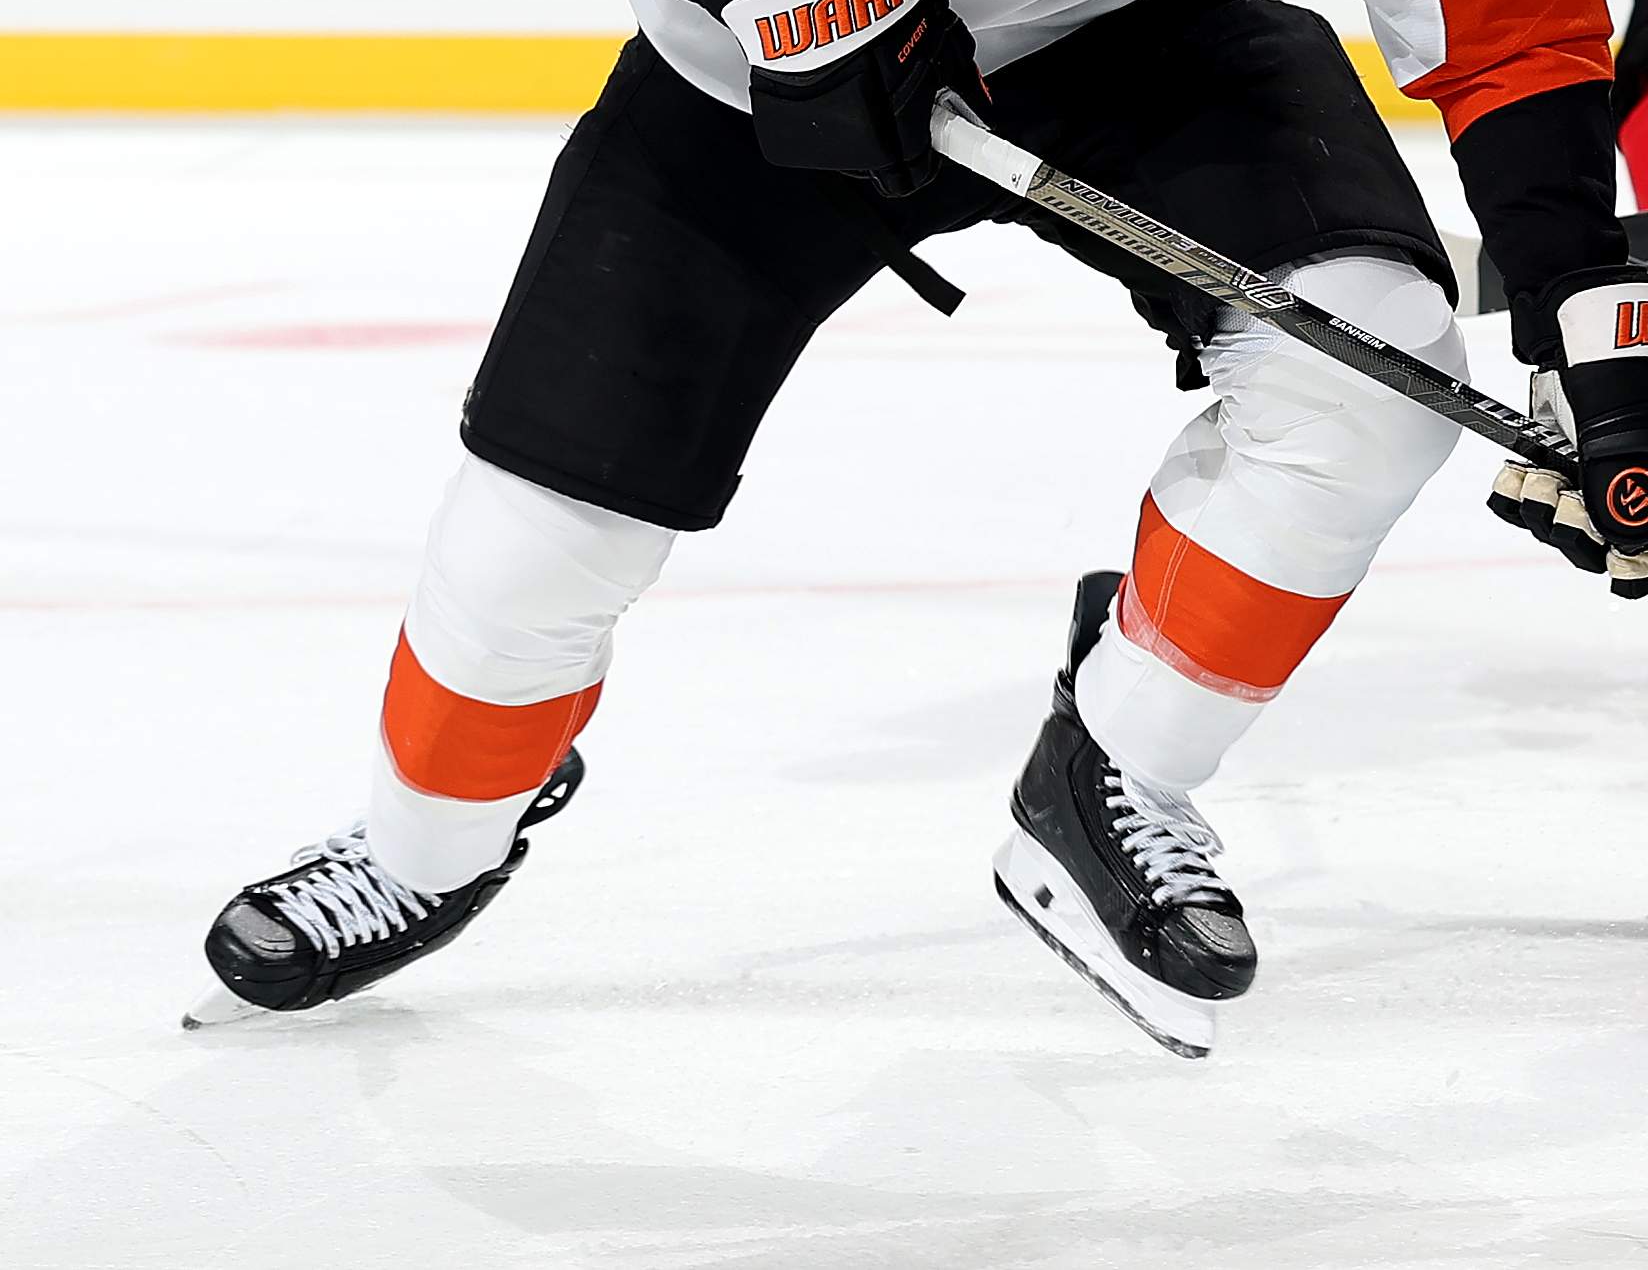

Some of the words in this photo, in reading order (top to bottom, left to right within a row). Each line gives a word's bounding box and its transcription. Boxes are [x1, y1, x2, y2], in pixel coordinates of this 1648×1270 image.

[896, 17, 928, 64] COVERT
[1042, 195, 1176, 266] WARRIOR
[1057, 178, 1175, 241] NOVIUM
